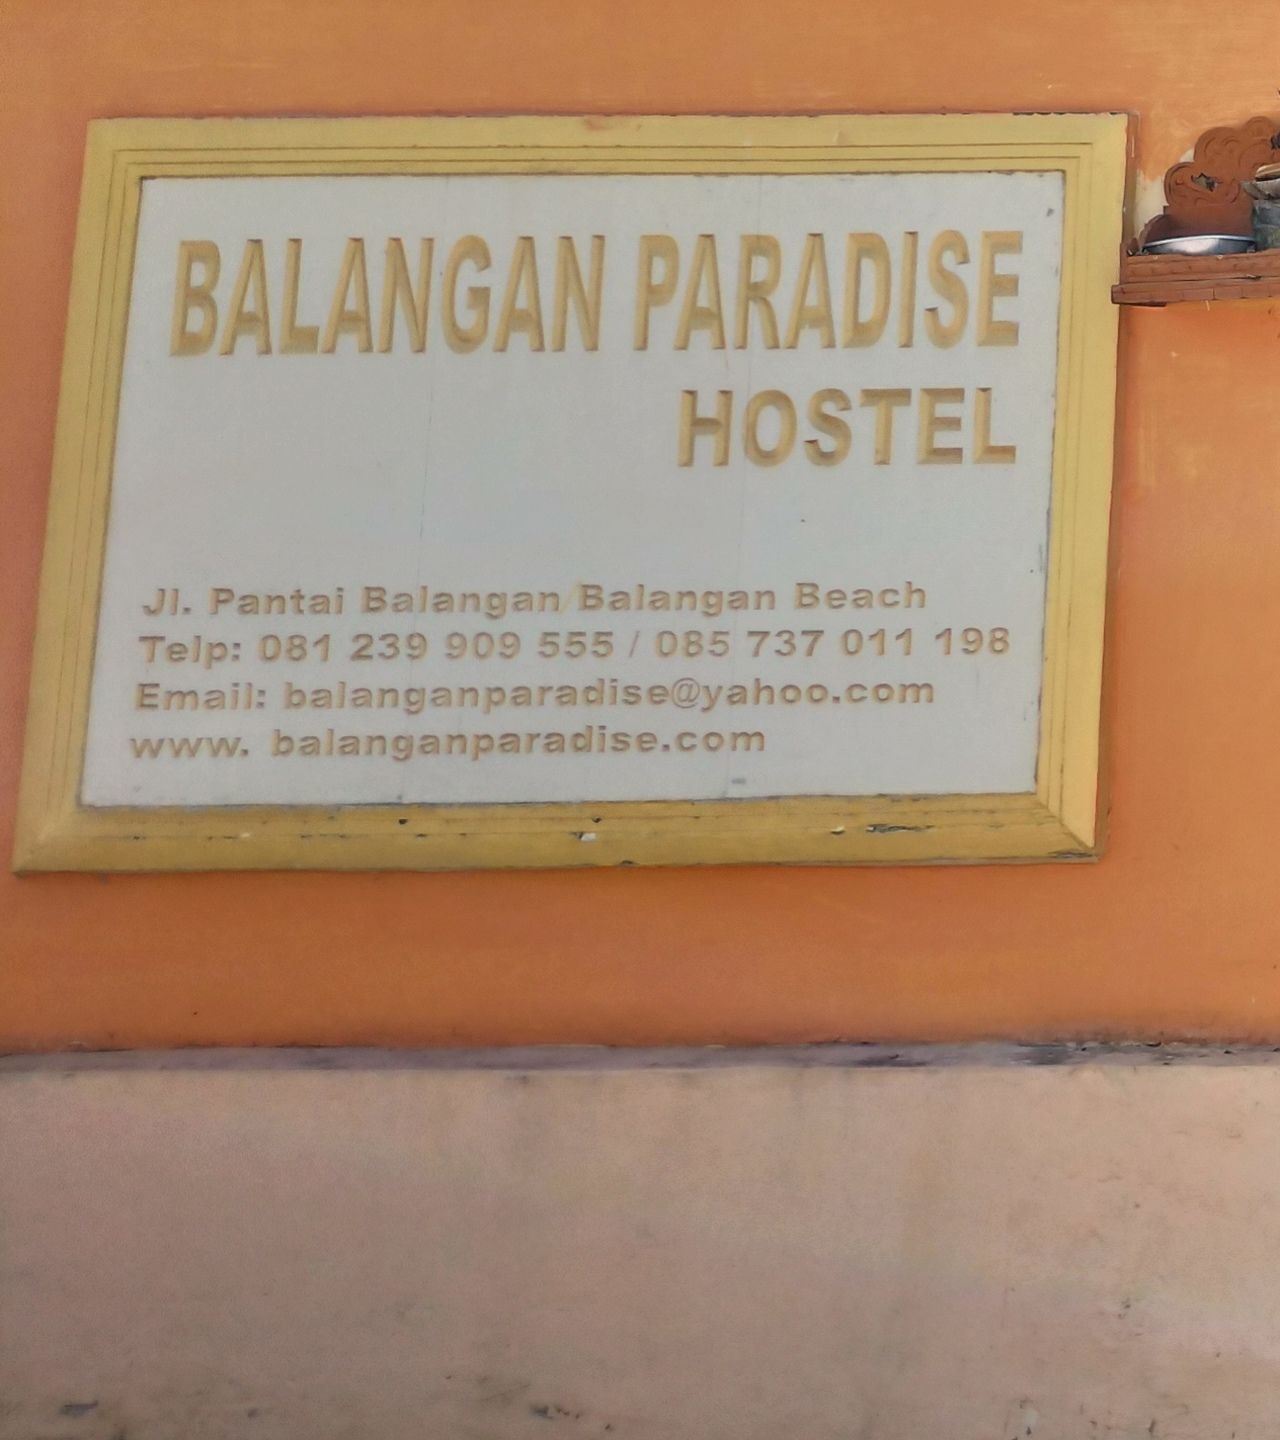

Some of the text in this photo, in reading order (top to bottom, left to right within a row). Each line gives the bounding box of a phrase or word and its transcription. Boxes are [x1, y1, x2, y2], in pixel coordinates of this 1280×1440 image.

[169, 229, 1024, 356] BALANGAN PARADISE
[677, 386, 1017, 467] HOSTEL
[142, 586, 192, 616] Jl.
[207, 586, 345, 616] Pantai
[794, 580, 928, 611] Beach
[138, 626, 1011, 670] Telp: 081 239 909 555 / 085 737 011 198
[134, 676, 935, 716] Email: balanganparadise@yahoo.com
[129, 724, 767, 763] www. balanganparadise.com
